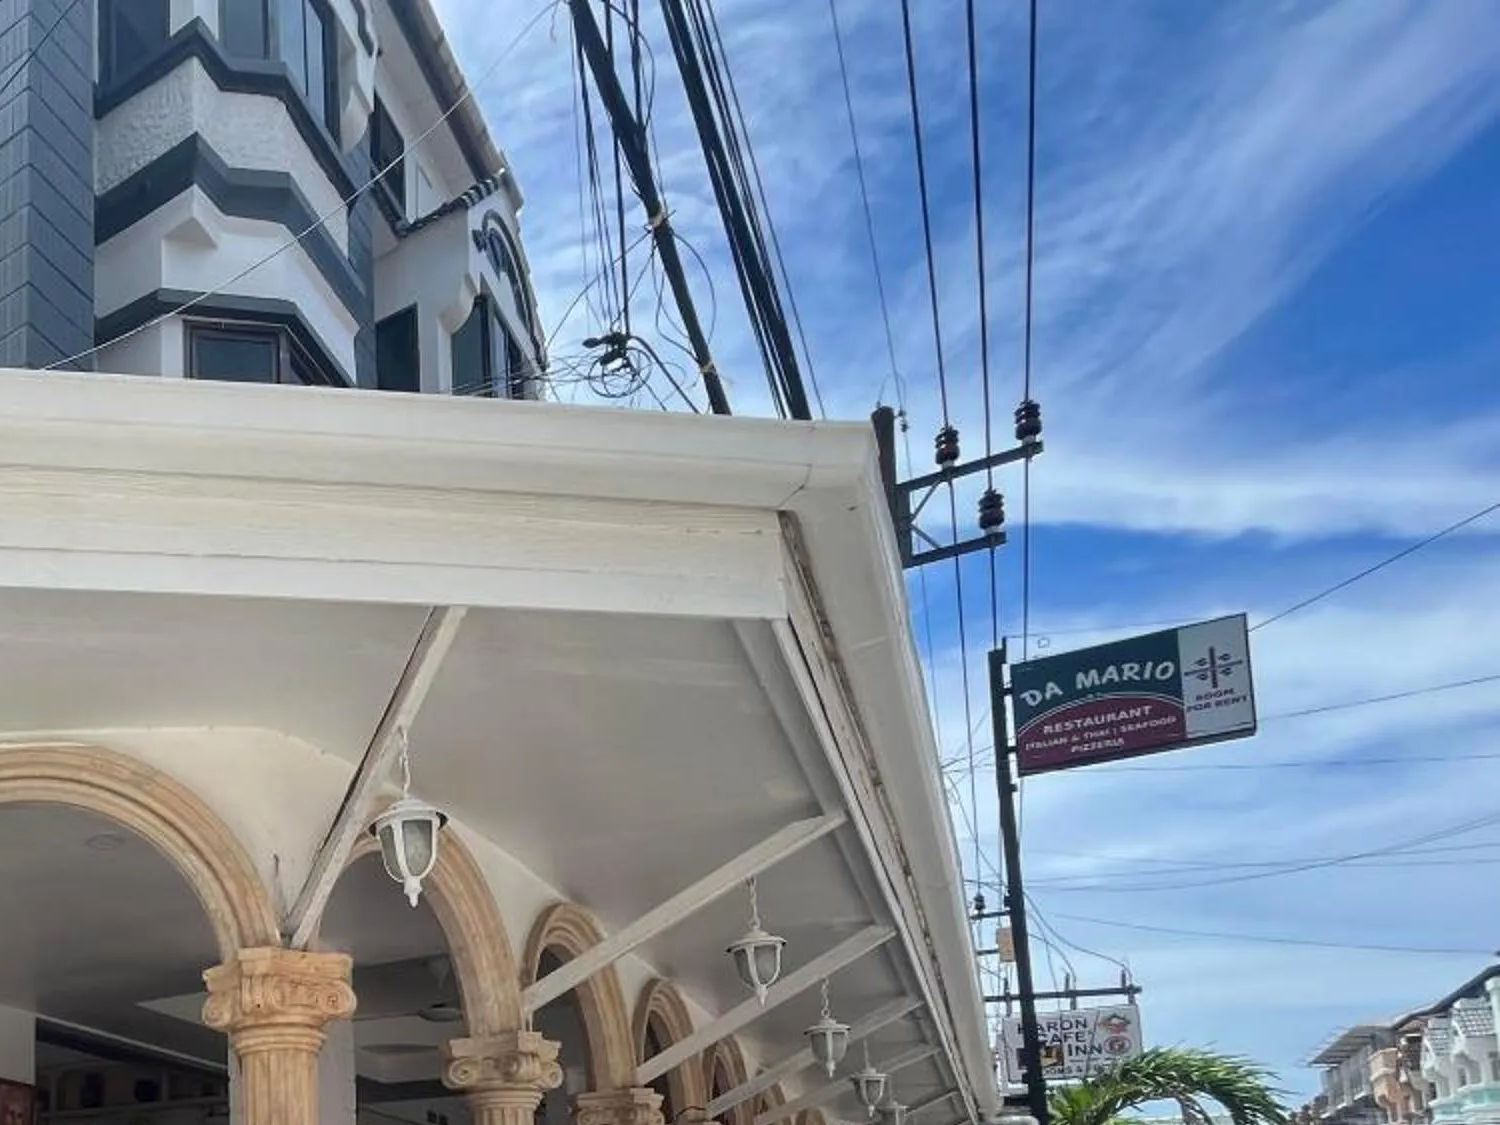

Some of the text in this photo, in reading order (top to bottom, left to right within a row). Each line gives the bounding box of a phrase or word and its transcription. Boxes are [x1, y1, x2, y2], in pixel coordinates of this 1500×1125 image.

[1019, 660, 1175, 708] DA MARIO
[1195, 687, 1234, 701] ROOM
[1186, 694, 1248, 713] FOR RENT
[1042, 704, 1152, 735] RESTAURANT
[1025, 736, 1069, 752] ITALIAN
[1070, 736, 1125, 753] PIZZERIA
[1067, 1042, 1103, 1057] INN
